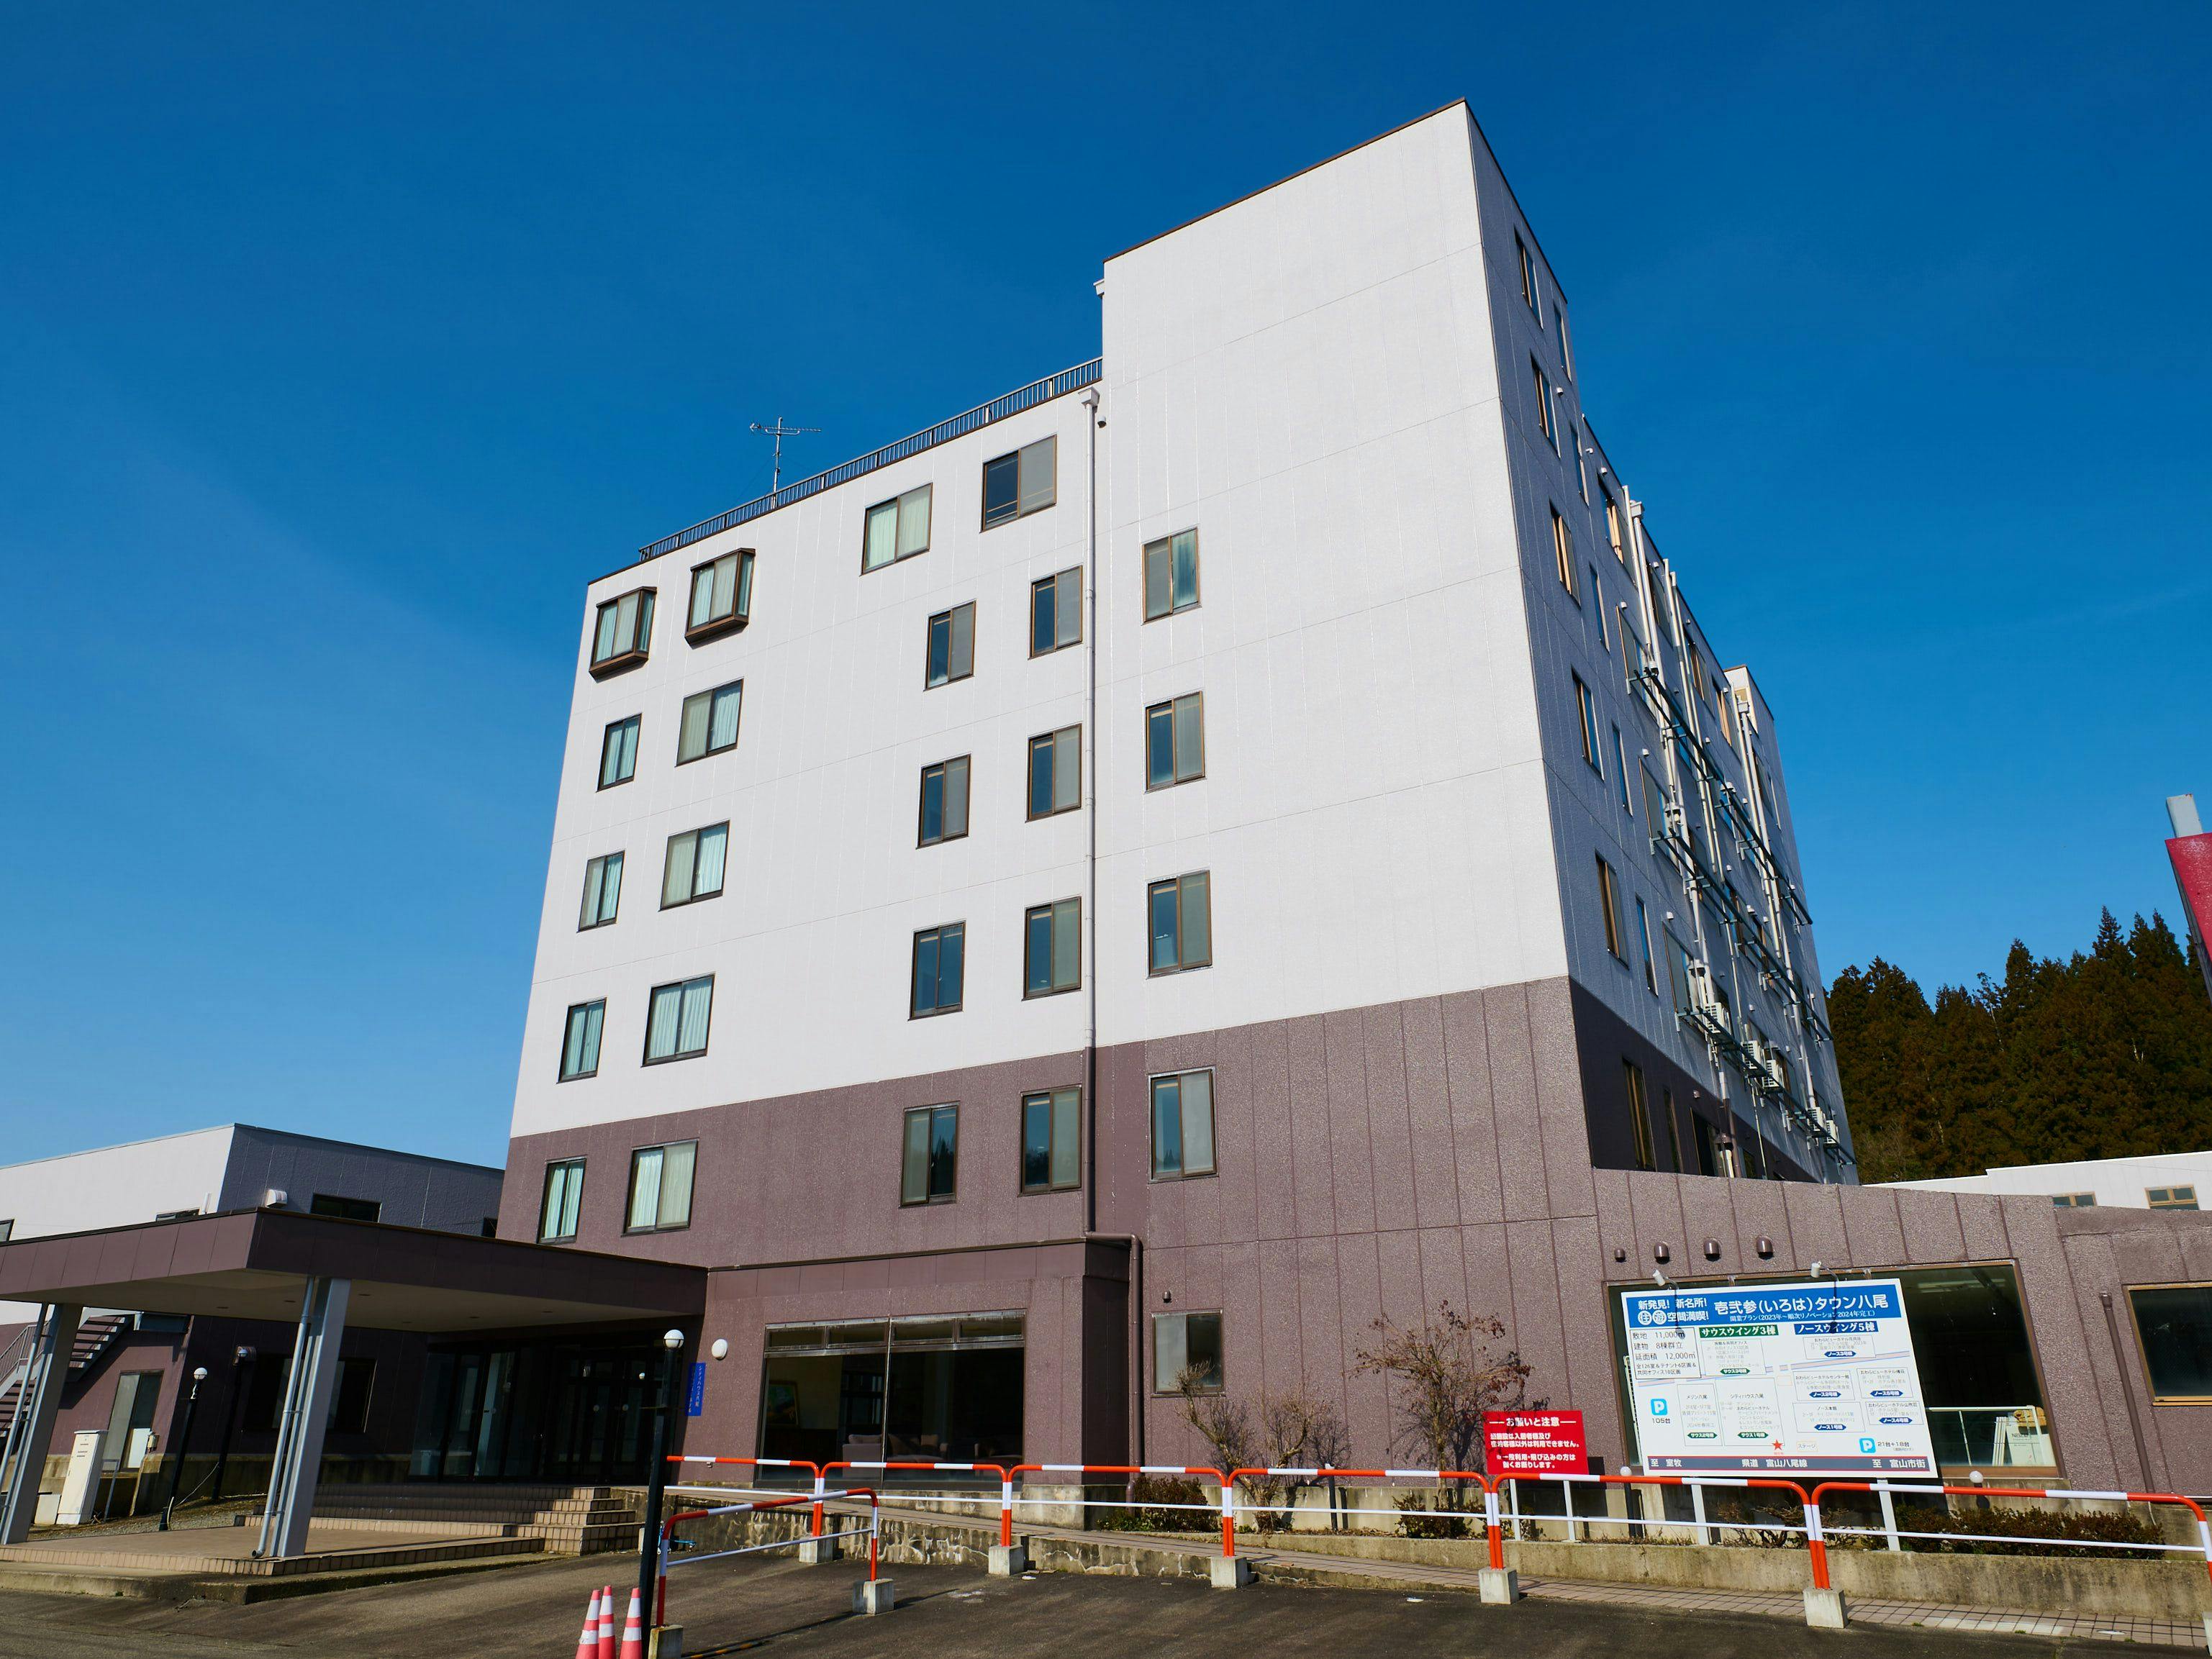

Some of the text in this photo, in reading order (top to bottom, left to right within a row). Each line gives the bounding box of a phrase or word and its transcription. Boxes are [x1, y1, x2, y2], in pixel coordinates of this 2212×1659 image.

[1701, 1326, 1776, 1337] サウスウイング3棟
[1798, 1322, 1875, 1334] ノースウイング5棟
[1651, 1458, 1926, 1468] 至 室牧 県道 富山八尾線 至 富山市街
